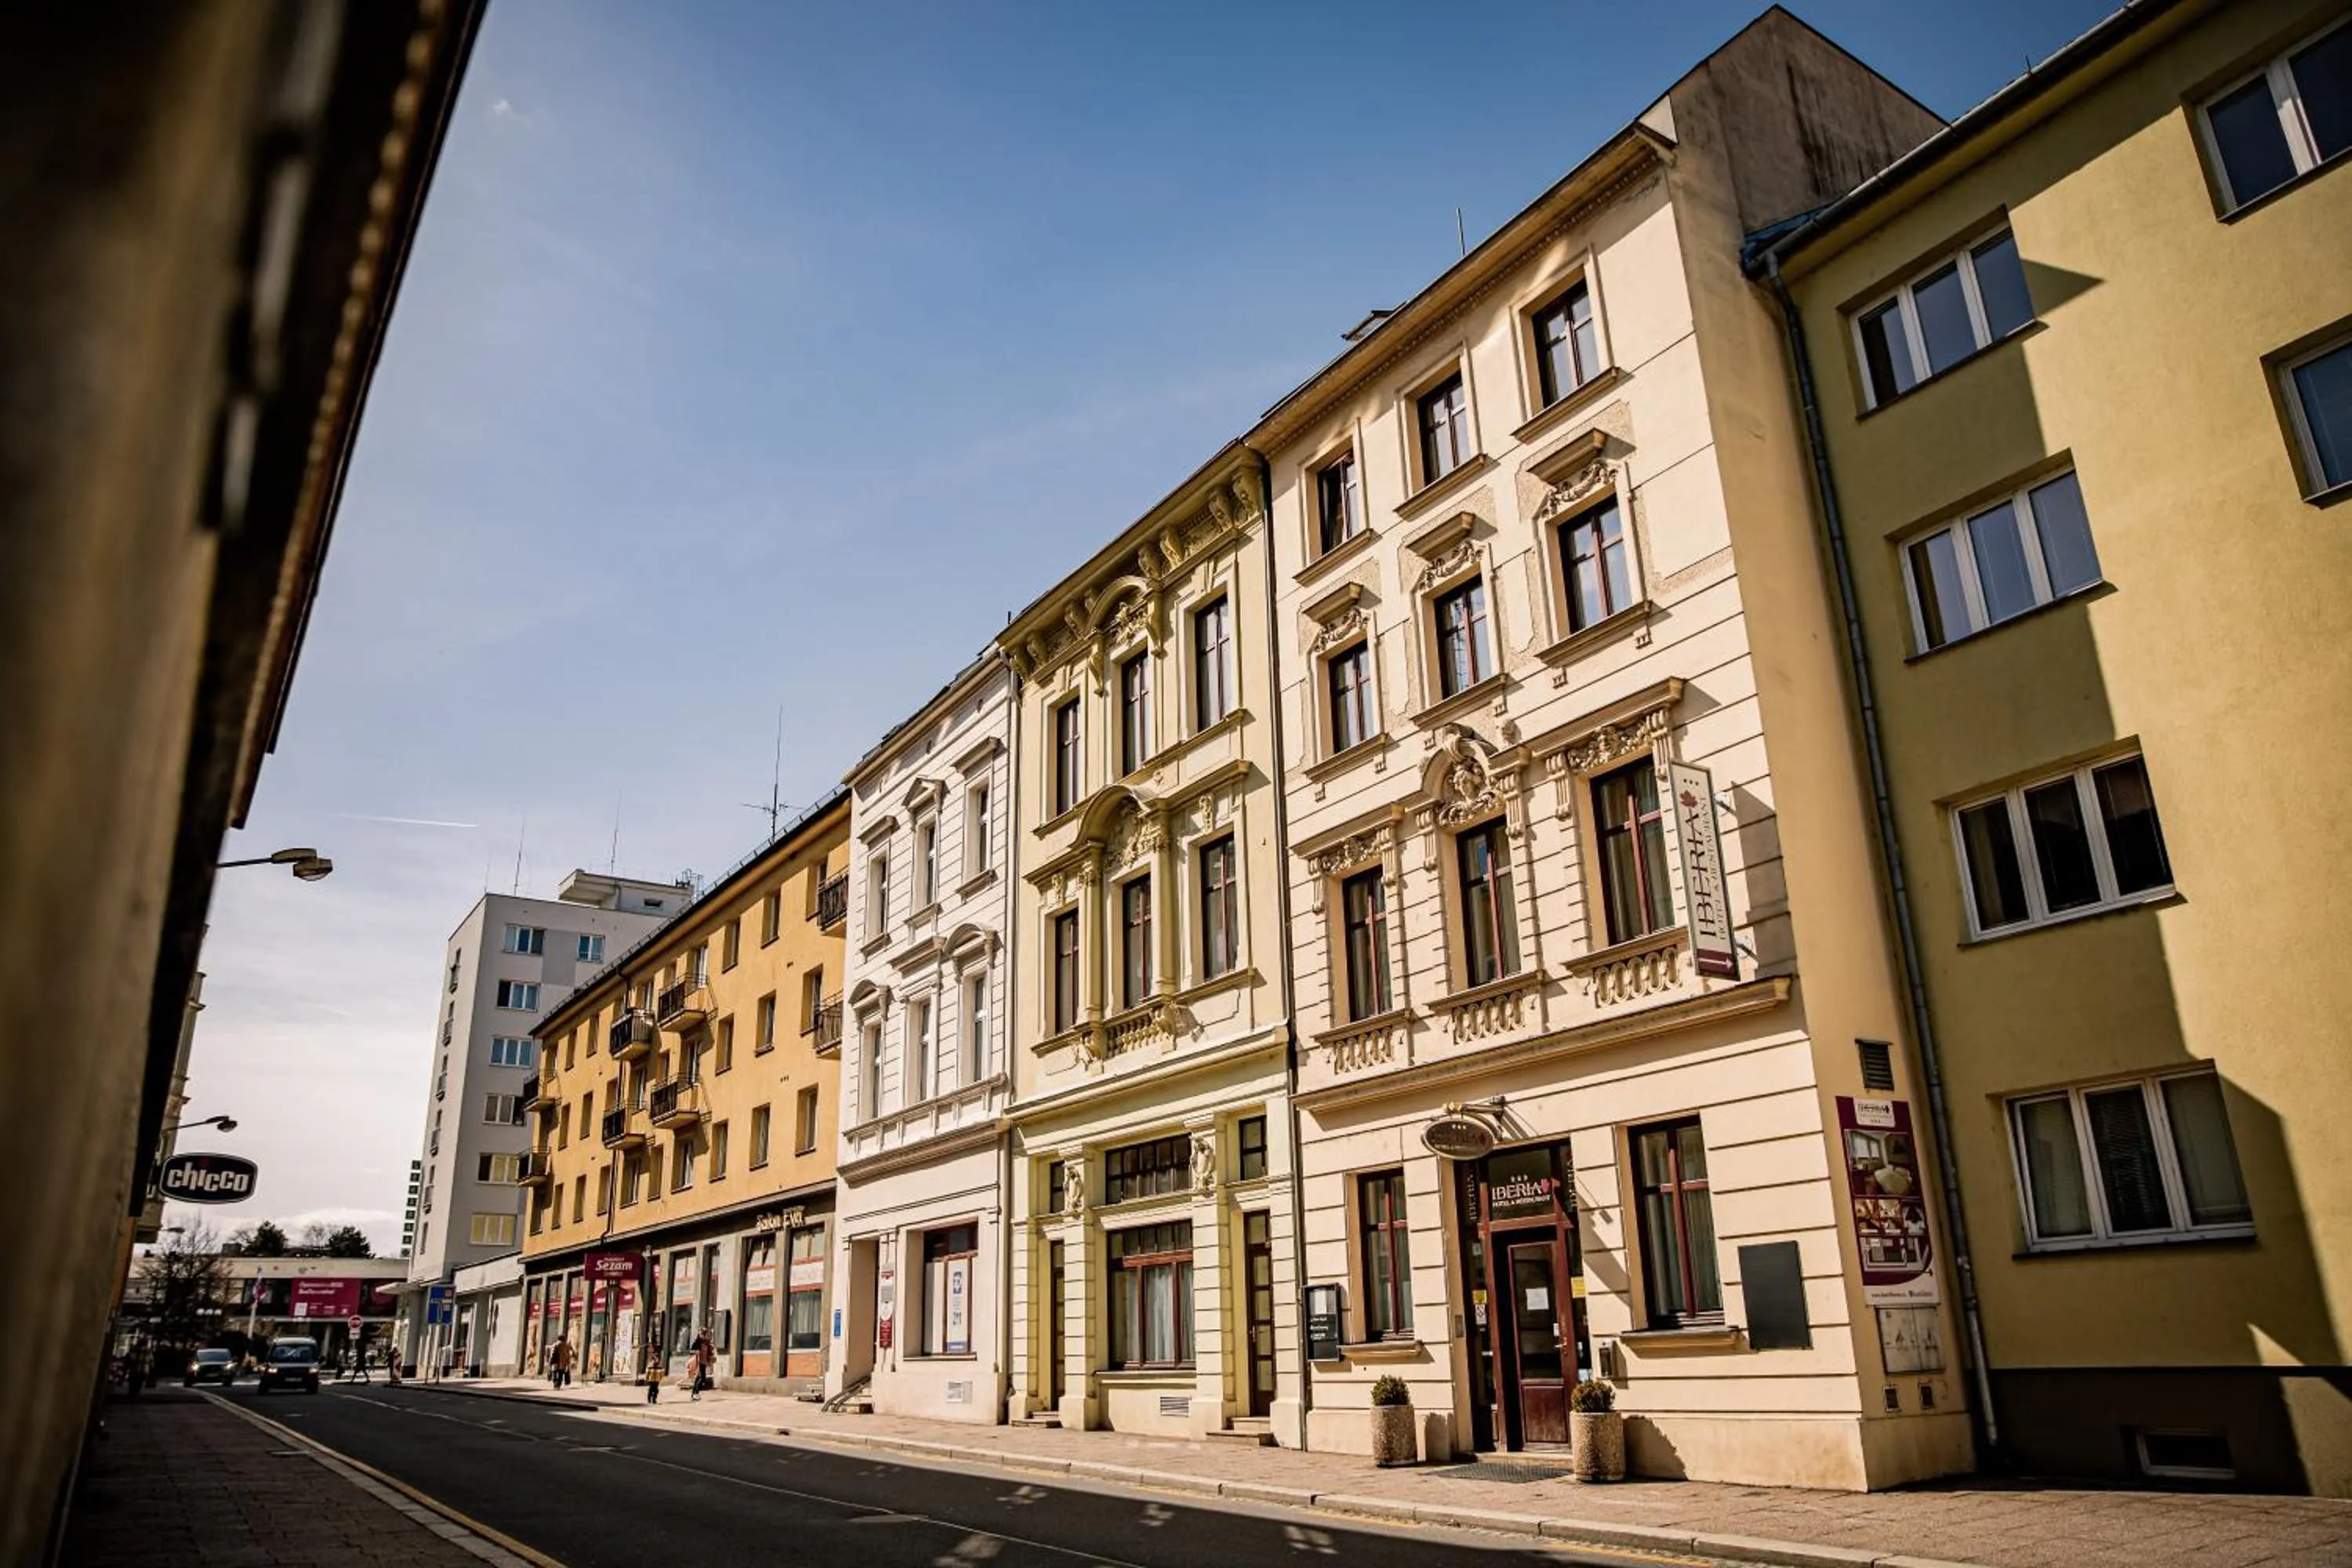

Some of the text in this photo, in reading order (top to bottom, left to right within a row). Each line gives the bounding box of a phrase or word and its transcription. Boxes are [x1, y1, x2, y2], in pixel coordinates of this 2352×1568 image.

[1685, 813, 1716, 936] IBERIA
[167, 1162, 249, 1192] chicco
[1492, 1182, 1542, 1200] IBERIA
[595, 1259, 633, 1271] Sezam
